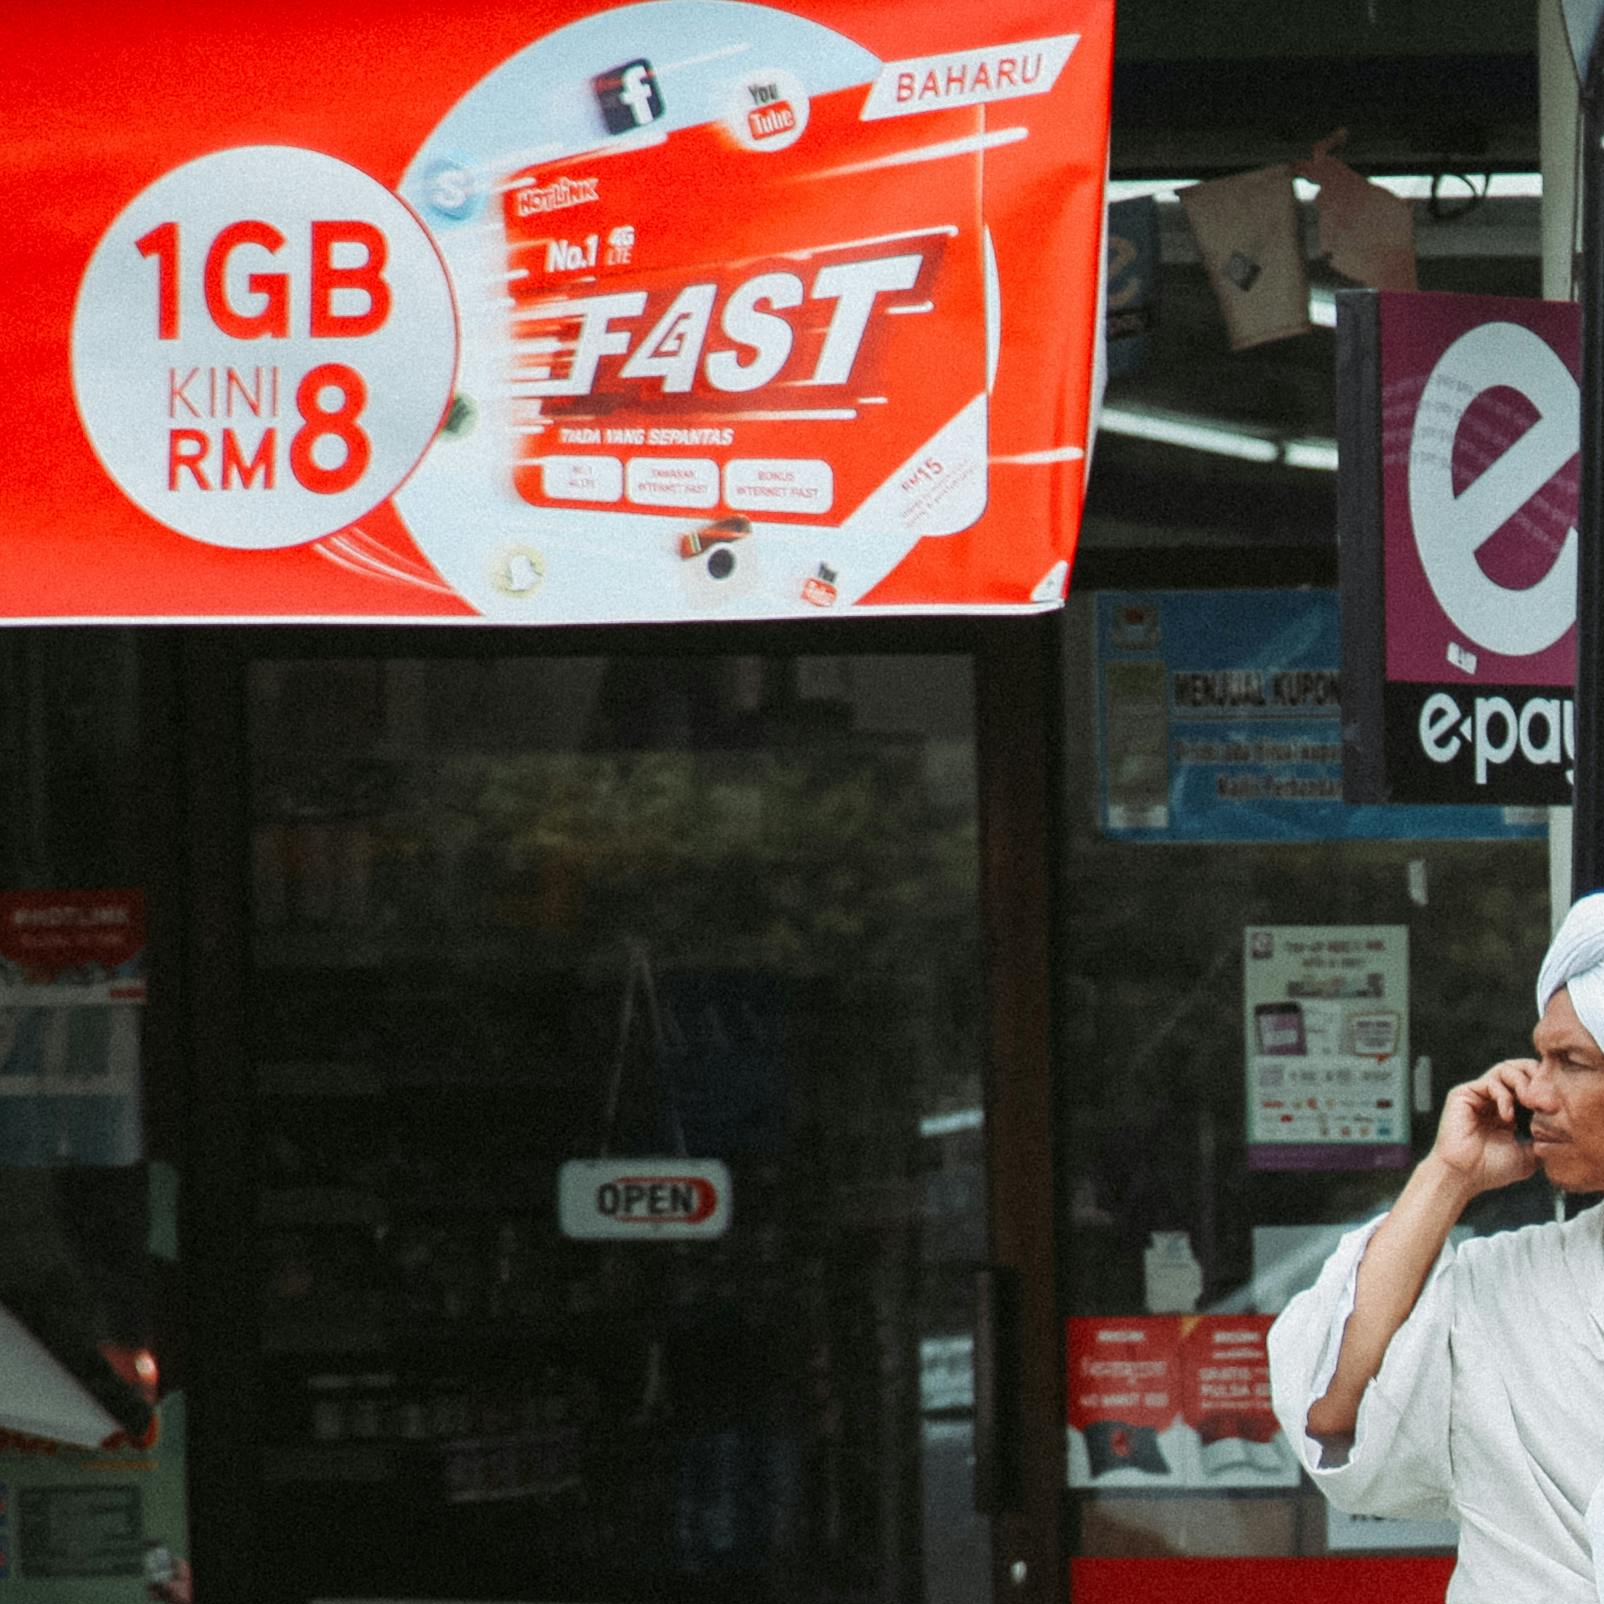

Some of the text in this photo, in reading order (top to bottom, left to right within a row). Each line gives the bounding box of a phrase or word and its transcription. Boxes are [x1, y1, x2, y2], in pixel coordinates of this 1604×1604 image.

[896, 53, 1044, 103] BAHARU
[547, 234, 599, 272] No.1
[134, 219, 393, 340] 1GB
[167, 365, 279, 418] KINI
[597, 1183, 694, 1216] OPEN
